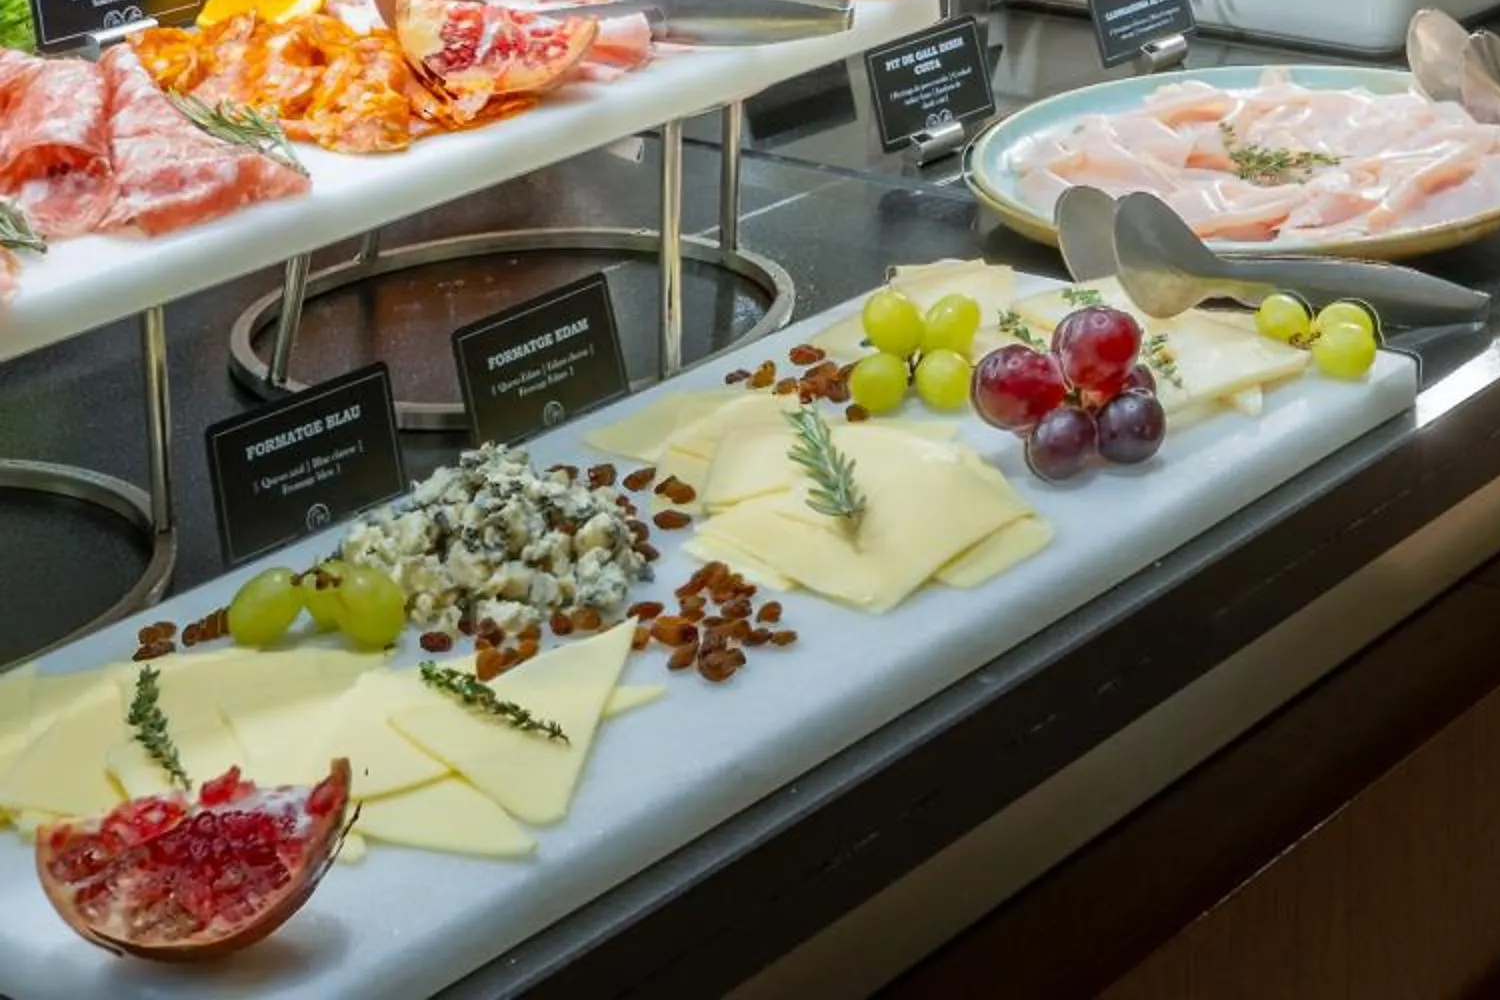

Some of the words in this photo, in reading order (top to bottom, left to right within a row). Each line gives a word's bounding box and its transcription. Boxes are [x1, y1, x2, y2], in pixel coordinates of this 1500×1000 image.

[488, 333, 553, 370] FORMATGE
[554, 318, 588, 342] EDAM
[246, 419, 323, 460] FORMATGE
[325, 404, 360, 429] BLAU
